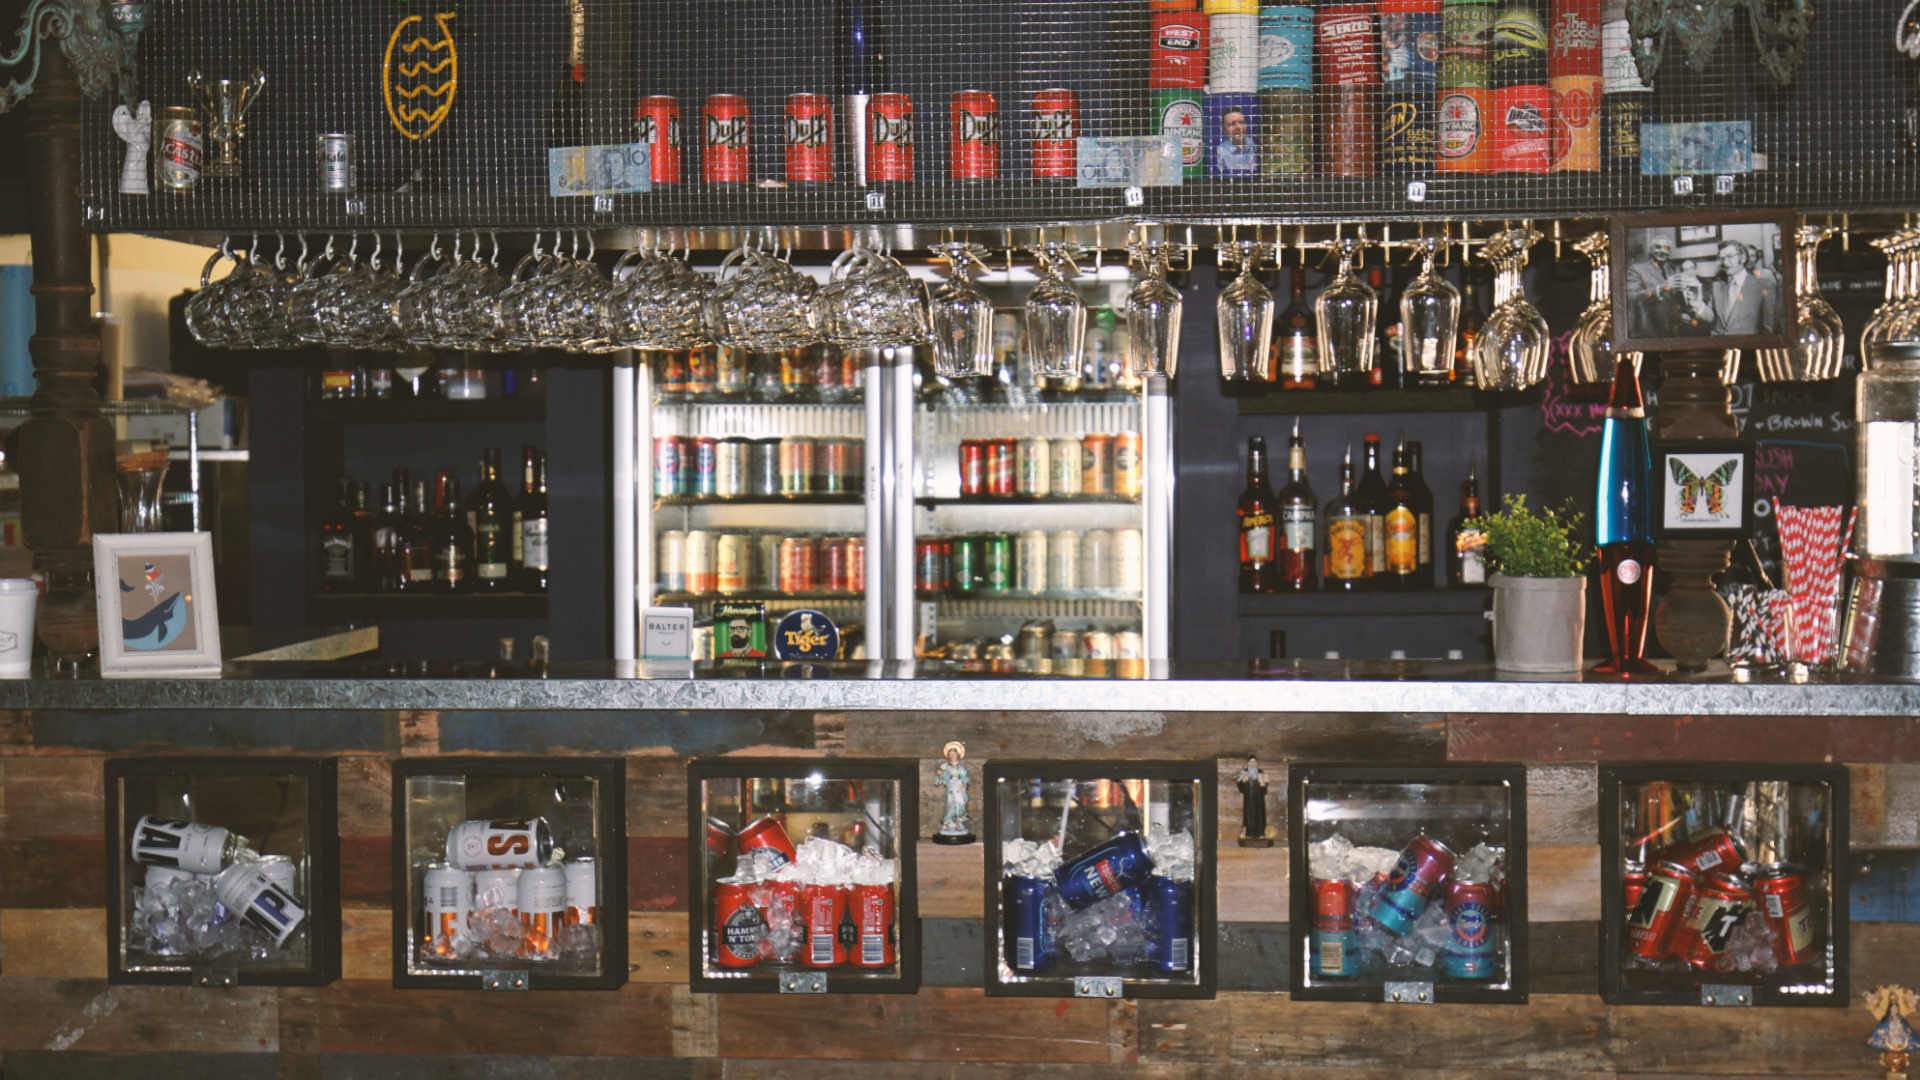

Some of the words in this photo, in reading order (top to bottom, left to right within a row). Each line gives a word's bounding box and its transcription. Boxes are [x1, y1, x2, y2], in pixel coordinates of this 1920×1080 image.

[708, 114, 749, 149] Duff
[786, 112, 828, 148] Duff
[1766, 413, 1824, 432] BROWN
[648, 623, 685, 631] BALTER
[784, 629, 829, 652] Tiger
